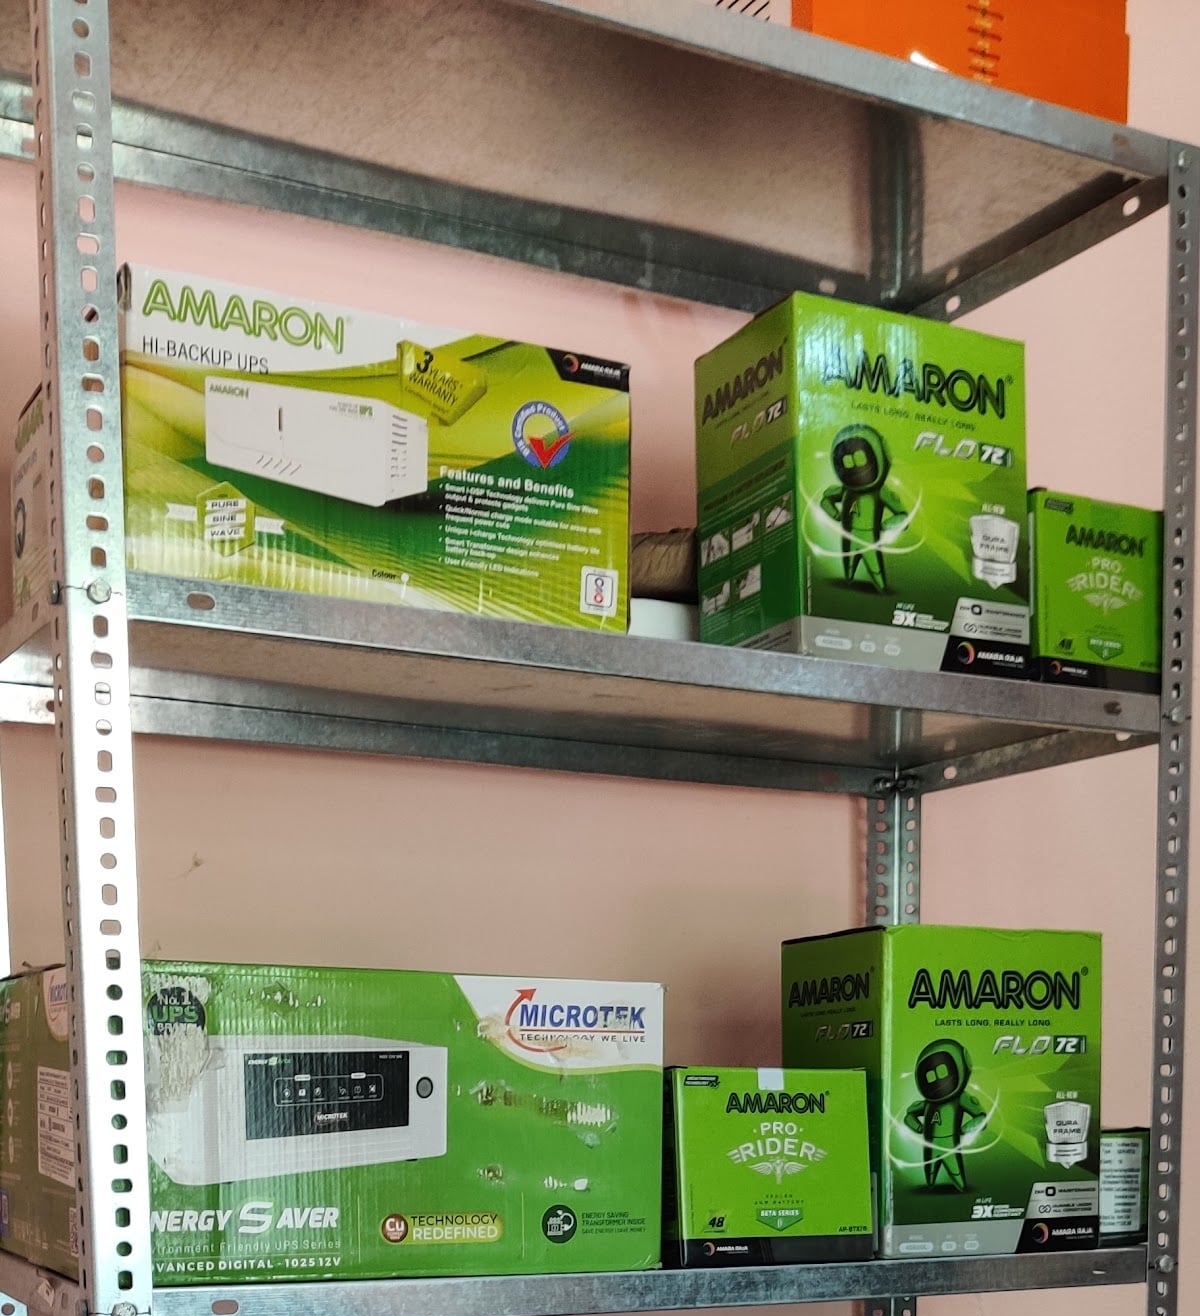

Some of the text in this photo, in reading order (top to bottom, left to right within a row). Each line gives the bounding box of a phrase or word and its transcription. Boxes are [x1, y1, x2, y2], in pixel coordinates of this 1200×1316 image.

[142, 279, 345, 355] AMARON
[142, 335, 269, 375] HI-BACKUP UPS
[416, 350, 434, 374] 3
[408, 371, 459, 407] WARRANTY
[702, 345, 784, 427] AMARON
[822, 348, 1006, 420] AMARON
[913, 429, 1006, 465] FLO 72
[439, 464, 575, 499] Features and Benefits
[211, 500, 240, 508] PURE
[212, 514, 237, 522] SINE
[210, 529, 240, 538] WAVE
[1065, 523, 1145, 559] AMARON
[1091, 556, 1123, 574] PRO
[371, 569, 397, 581] Colour
[1075, 571, 1139, 601] RIDER
[788, 971, 870, 1009] AMARON
[907, 967, 1081, 1011] AMARON
[151, 1004, 199, 1023] UPS
[519, 1003, 646, 1029] MICROTEK
[993, 1019, 1025, 1027] REALLY
[601, 1034, 646, 1044] WE LIVE
[815, 1022, 868, 1043] FLO 72
[992, 1034, 1079, 1056] FLO 72
[725, 1092, 825, 1114] AMARON
[1056, 1090, 1079, 1099] ALL-NEW
[759, 1121, 799, 1136] PRO
[1053, 1127, 1082, 1135] FRAME
[737, 1137, 818, 1162] RIDER
[410, 1214, 498, 1226] TECHNOLOGY
[760, 1209, 800, 1217] BETA SERIES
[971, 1204, 994, 1218] 3X
[150, 1209, 233, 1233] NERGY
[386, 1217, 406, 1232] Cu
[707, 1216, 726, 1228] 48
[412, 1225, 498, 1241] REDEFINED
[1051, 1226, 1093, 1237] AMARA RAJA
[220, 1239, 341, 1254] Friendly UPS Series
[218, 1258, 274, 1271] DIGITAL
[284, 1256, 316, 1268] 1025
[318, 1256, 341, 1267] 12V
